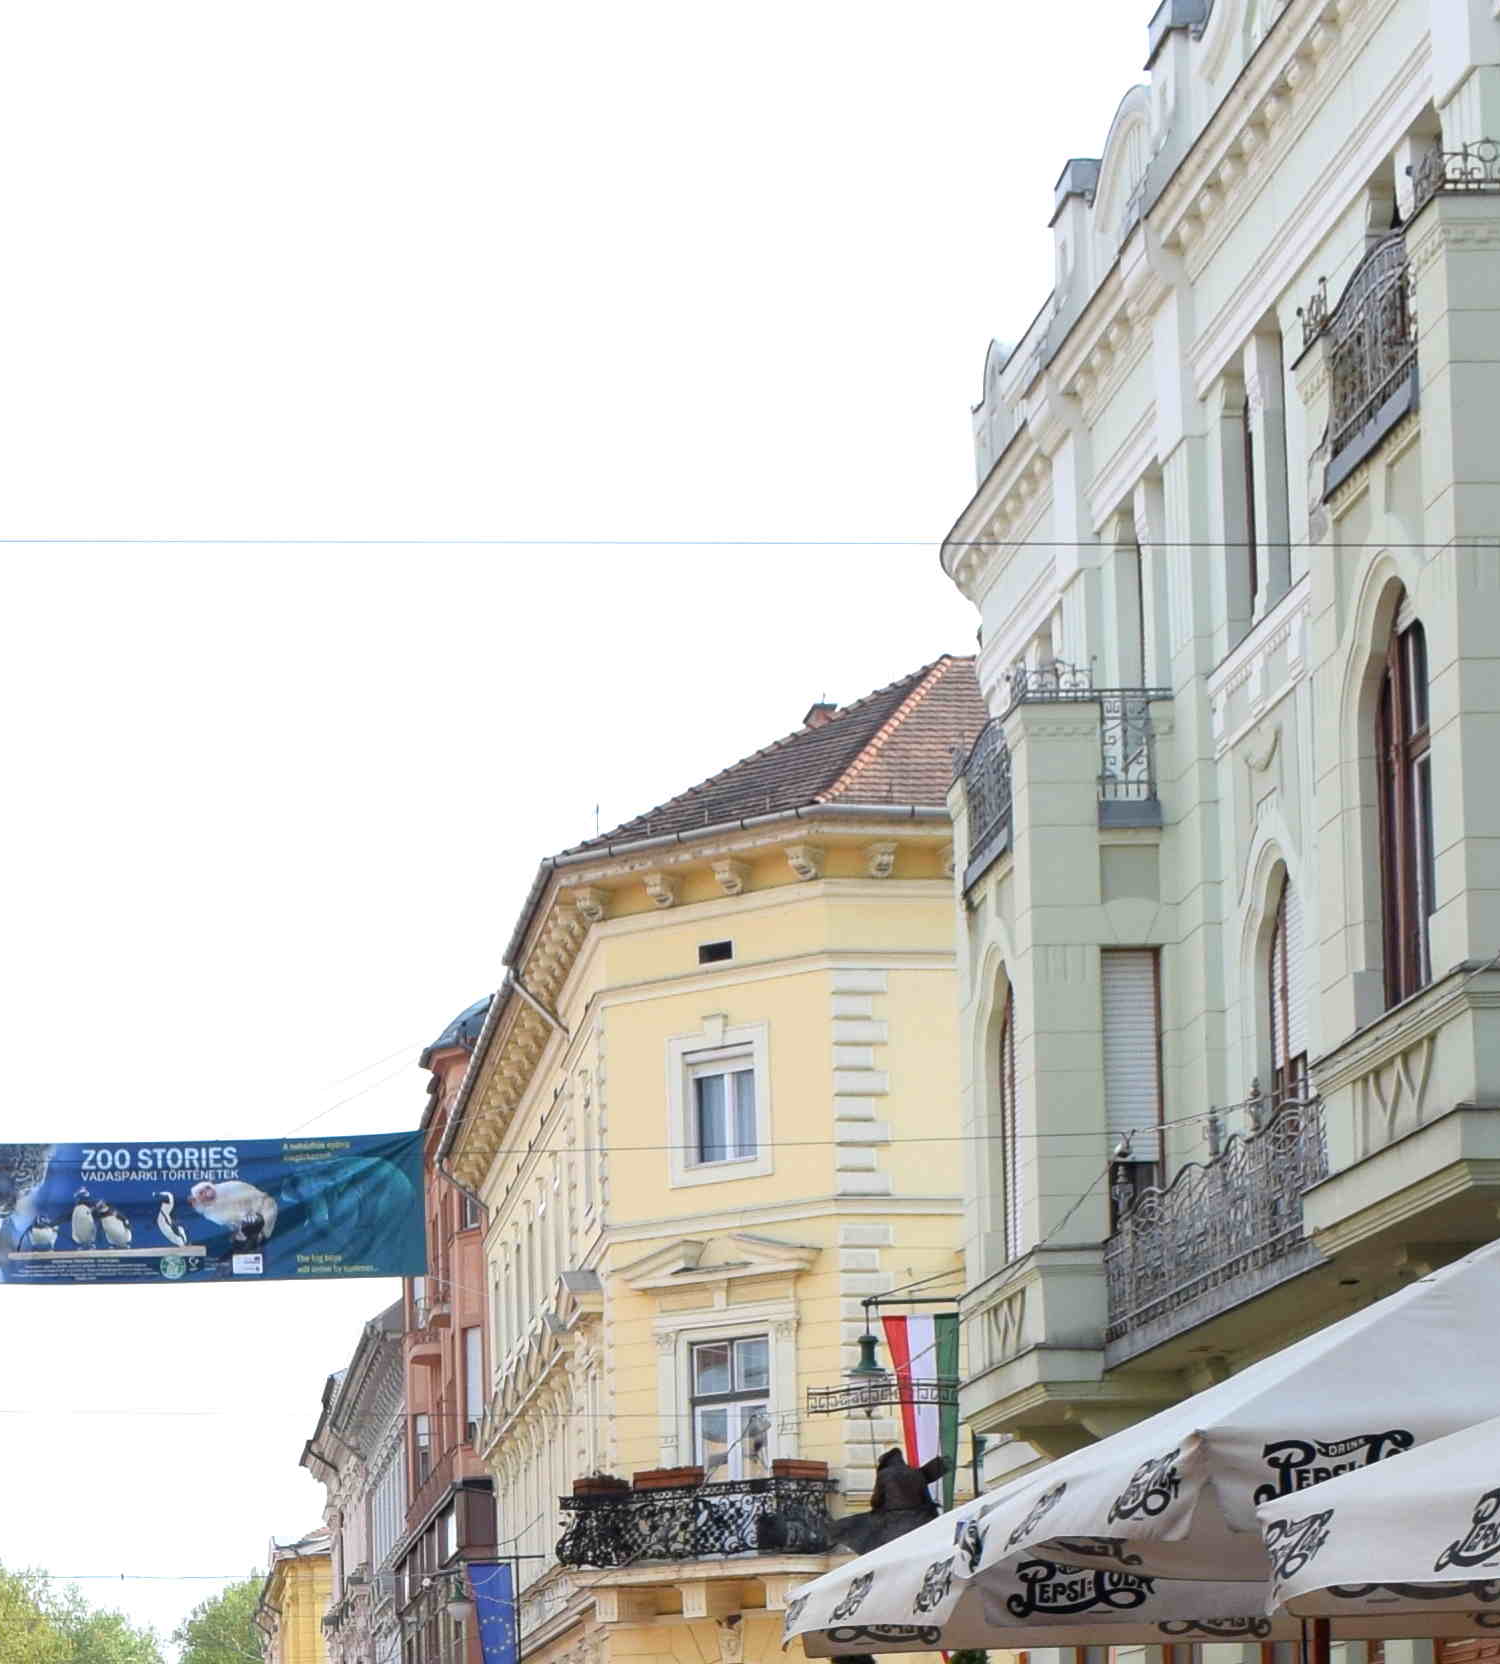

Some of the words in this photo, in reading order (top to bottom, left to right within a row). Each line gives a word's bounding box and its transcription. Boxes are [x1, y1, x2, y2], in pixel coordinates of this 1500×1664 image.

[81, 1149, 130, 1170] ZOO
[137, 1146, 238, 1169] STORIES
[81, 1170, 157, 1181] VADASPARKI
[162, 1168, 239, 1181] TÖRTÉNETEK
[1327, 1436, 1368, 1456] DRINK
